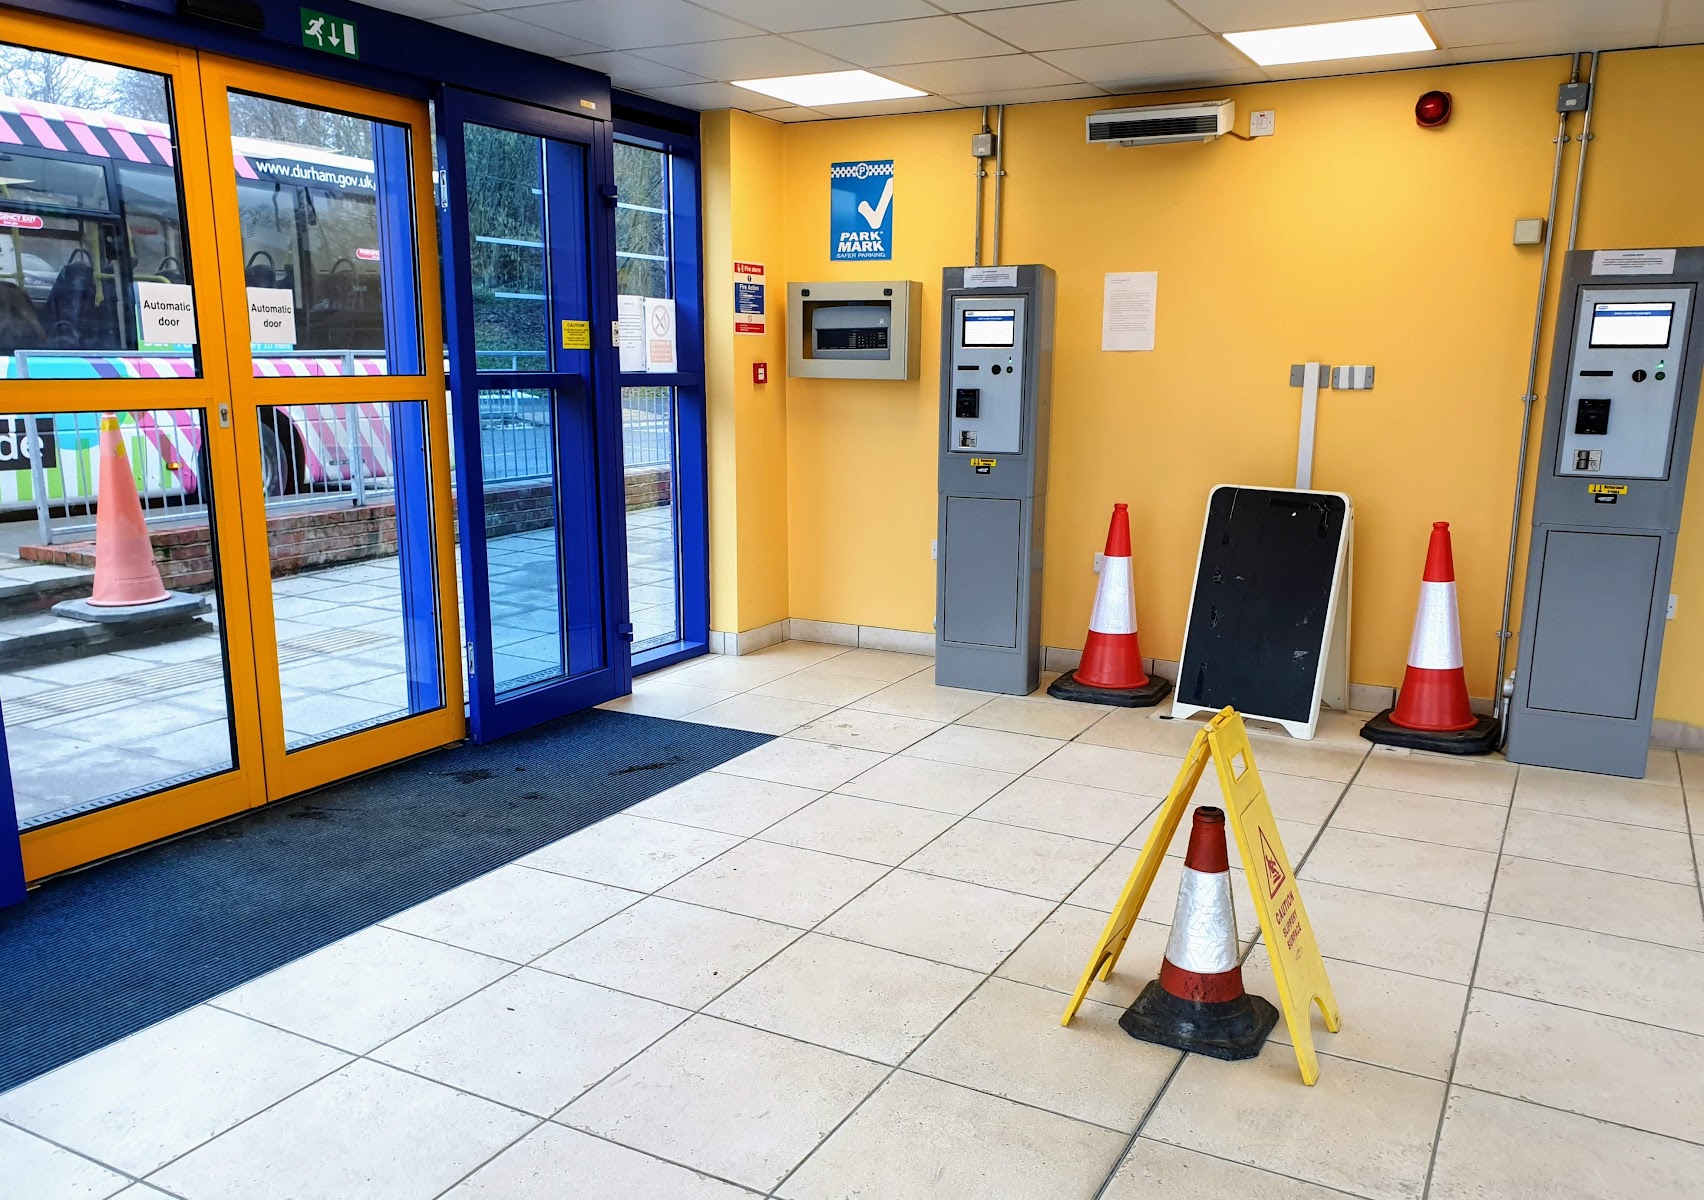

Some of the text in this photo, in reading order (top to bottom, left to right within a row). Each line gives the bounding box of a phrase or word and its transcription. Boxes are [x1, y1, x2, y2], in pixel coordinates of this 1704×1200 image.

[838, 241, 885, 252] MARK
[143, 300, 191, 312] Automatic
[251, 304, 292, 314] Automatic
[158, 317, 180, 326] door
[263, 319, 282, 327] door
[1275, 890, 1295, 925] CAUTION
[1282, 909, 1298, 938] SLIPPERY
[1287, 921, 1302, 950] SURFACE
